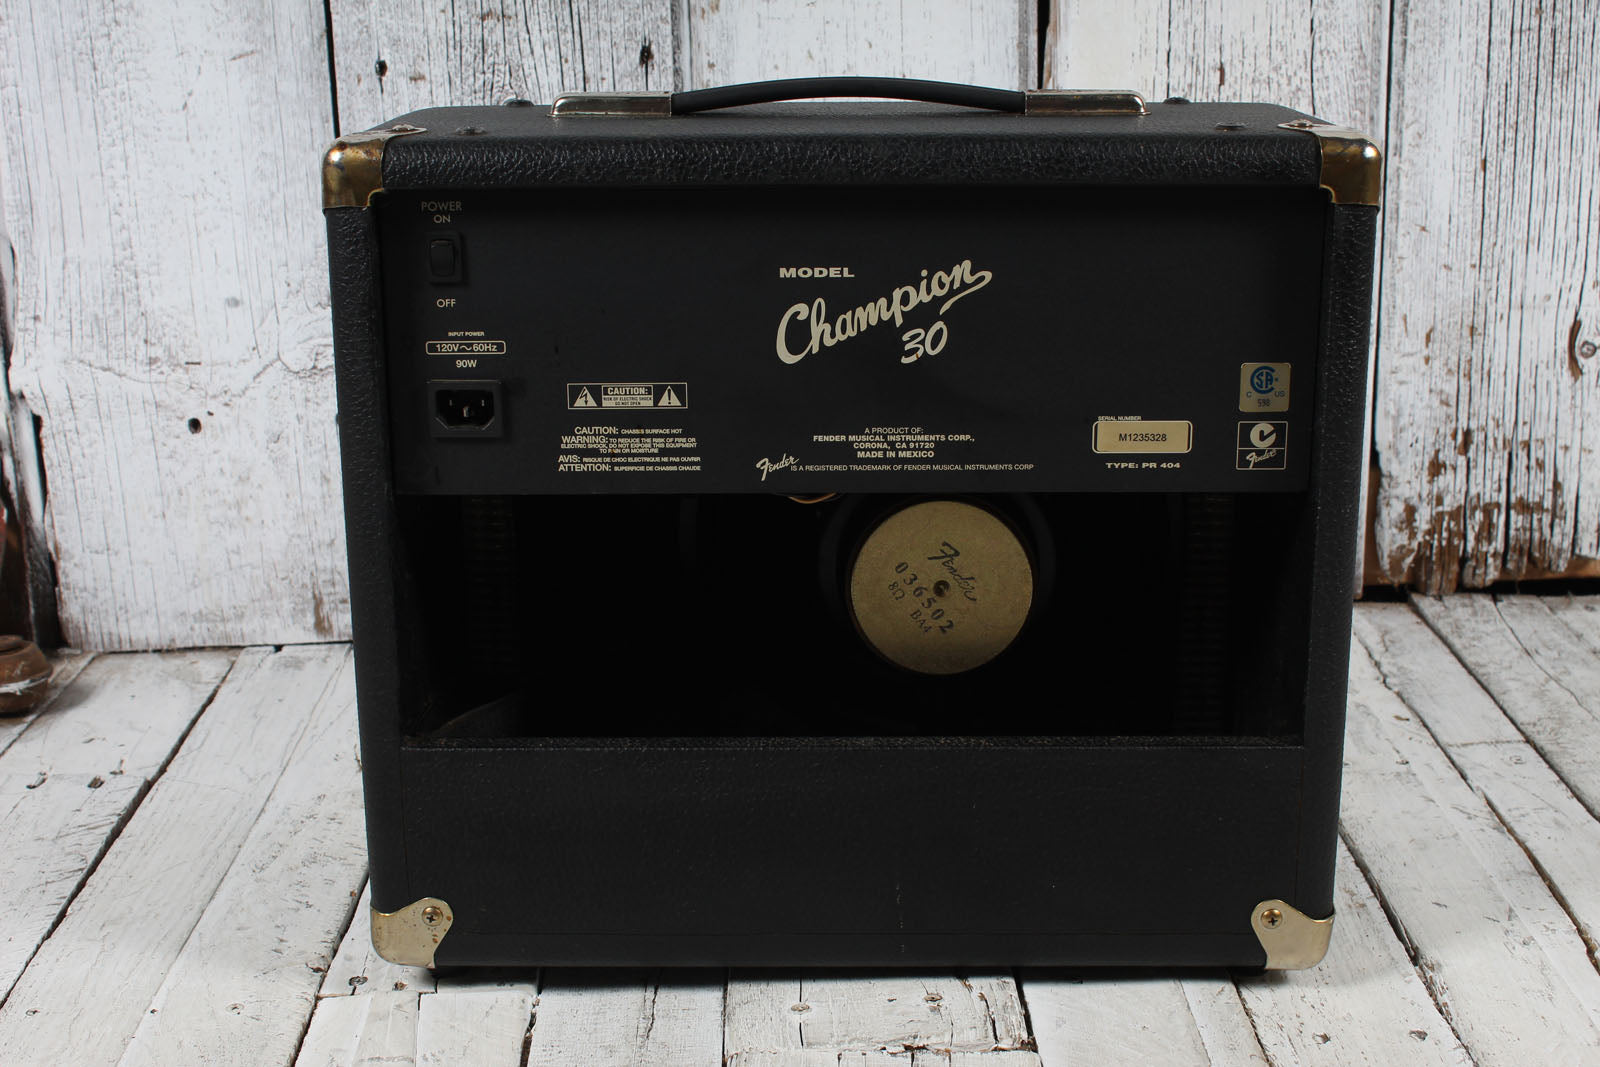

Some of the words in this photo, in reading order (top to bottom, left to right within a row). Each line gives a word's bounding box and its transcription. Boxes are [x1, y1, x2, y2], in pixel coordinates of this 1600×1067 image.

[421, 200, 462, 212] POWER
[434, 214, 451, 224] ON
[779, 267, 855, 278] MODEL
[436, 298, 456, 308] OFF
[776, 260, 993, 364] Champion
[901, 320, 948, 364] 30
[456, 360, 477, 368] 90W
[607, 387, 648, 395] CAUTION:
[1119, 434, 1167, 442] M1235328
[1246, 448, 1277, 469] Fender
[756, 453, 800, 481] Fender
[928, 541, 977, 601] Fender
[895, 562, 954, 634] 036502
